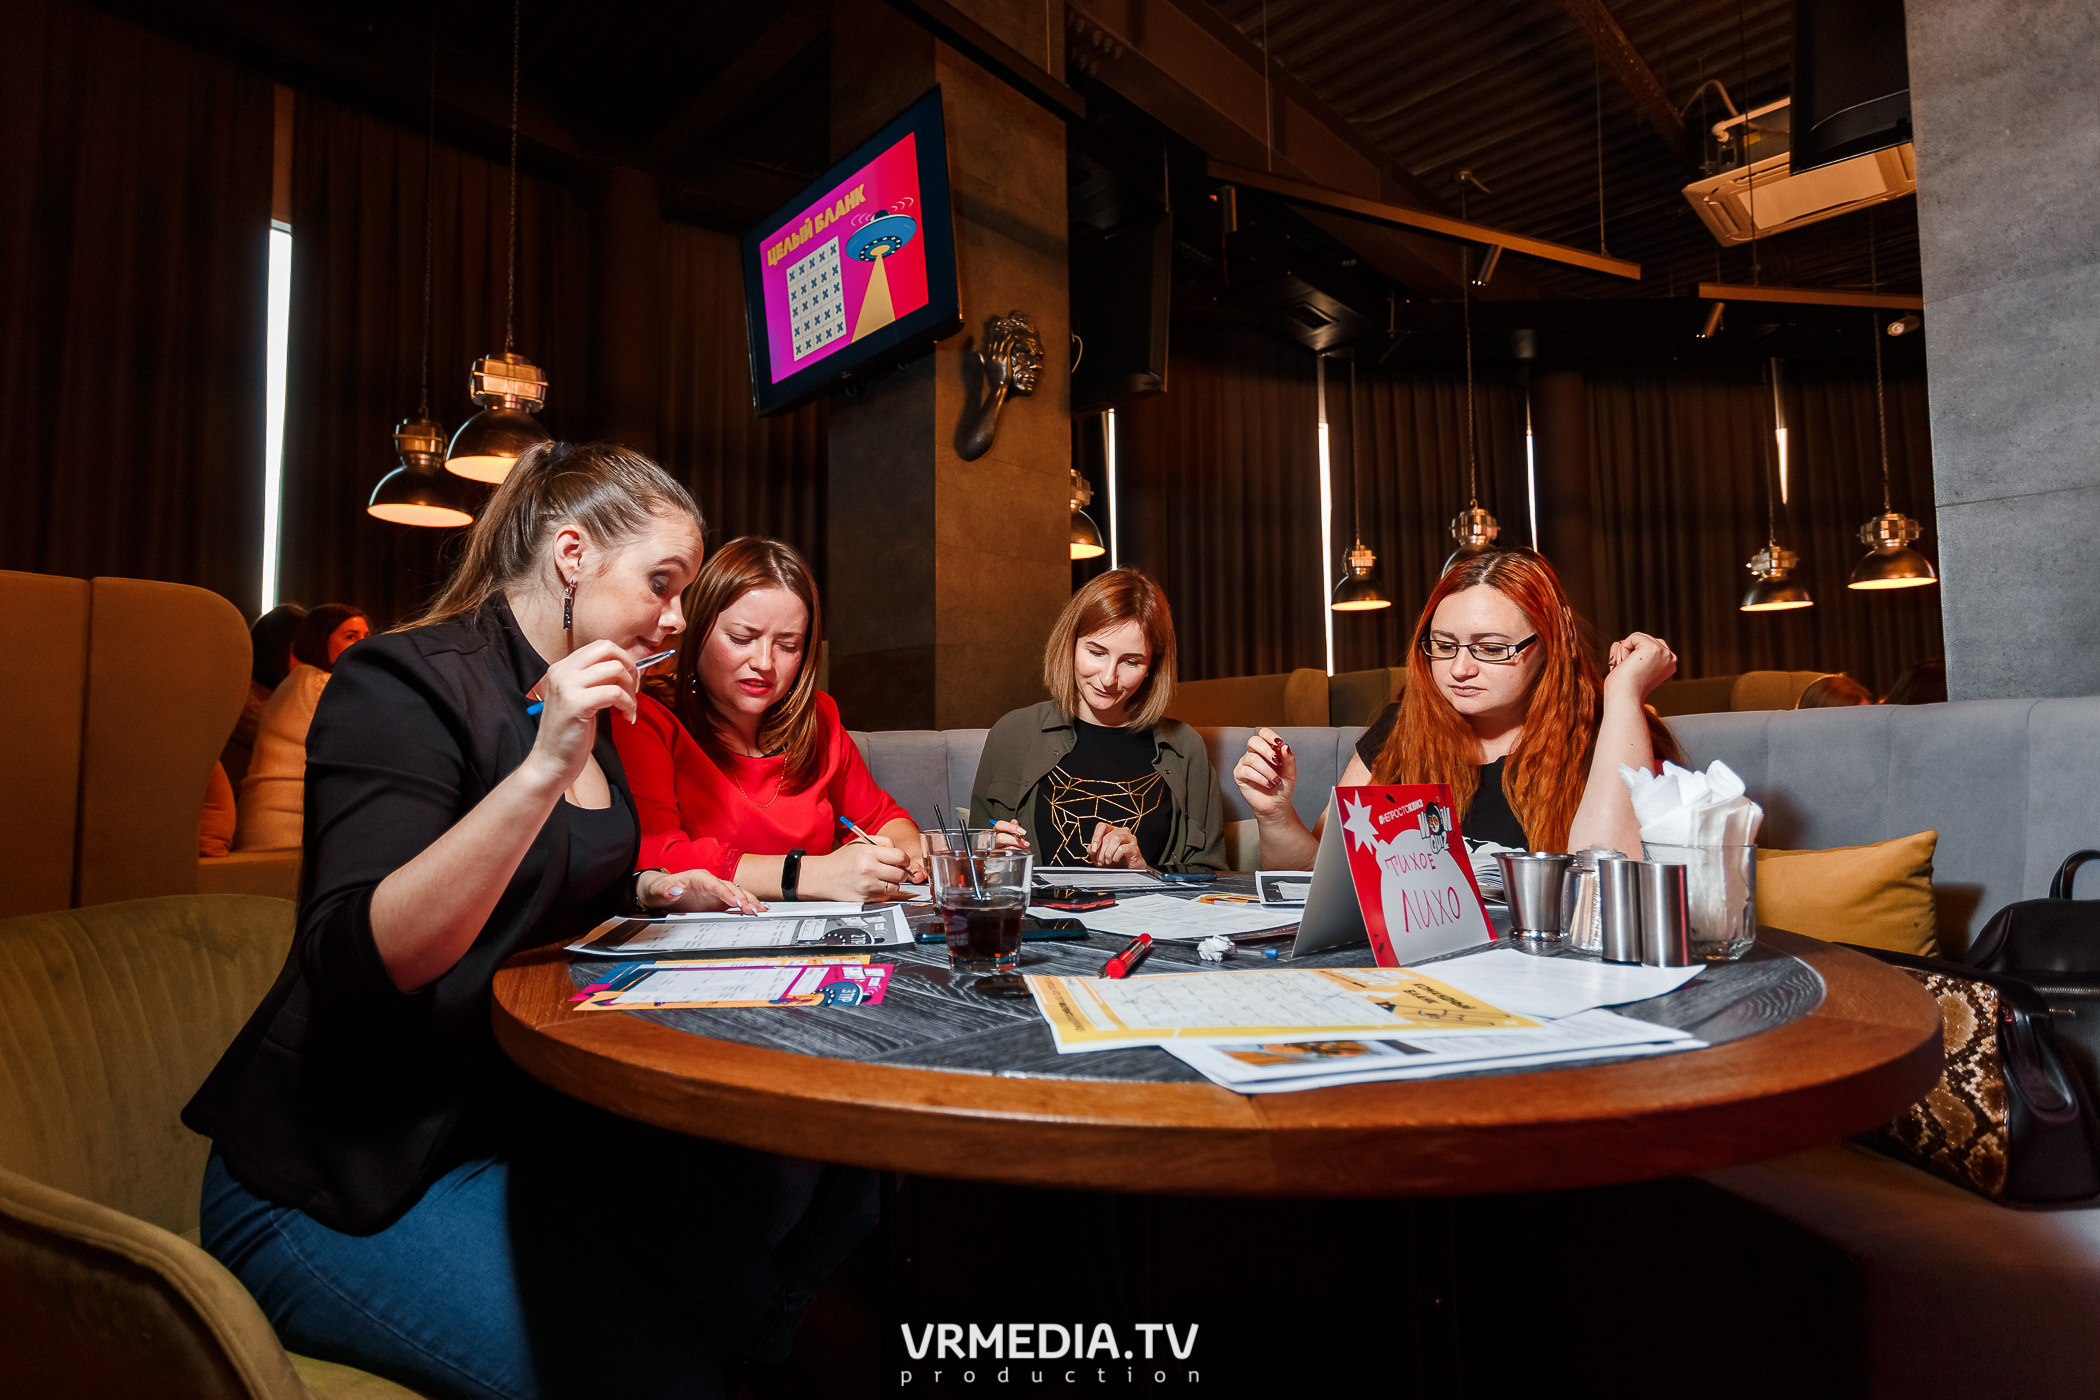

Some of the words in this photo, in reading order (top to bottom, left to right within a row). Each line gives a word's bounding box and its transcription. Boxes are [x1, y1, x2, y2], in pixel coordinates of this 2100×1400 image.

[767, 217, 813, 266] ЦЕЛЫЙ
[814, 184, 866, 234] БЛАНК
[1430, 830, 1450, 855] QUIZ
[1384, 851, 1436, 876] ТИХОЕ
[1401, 886, 1461, 933] ЛИХО
